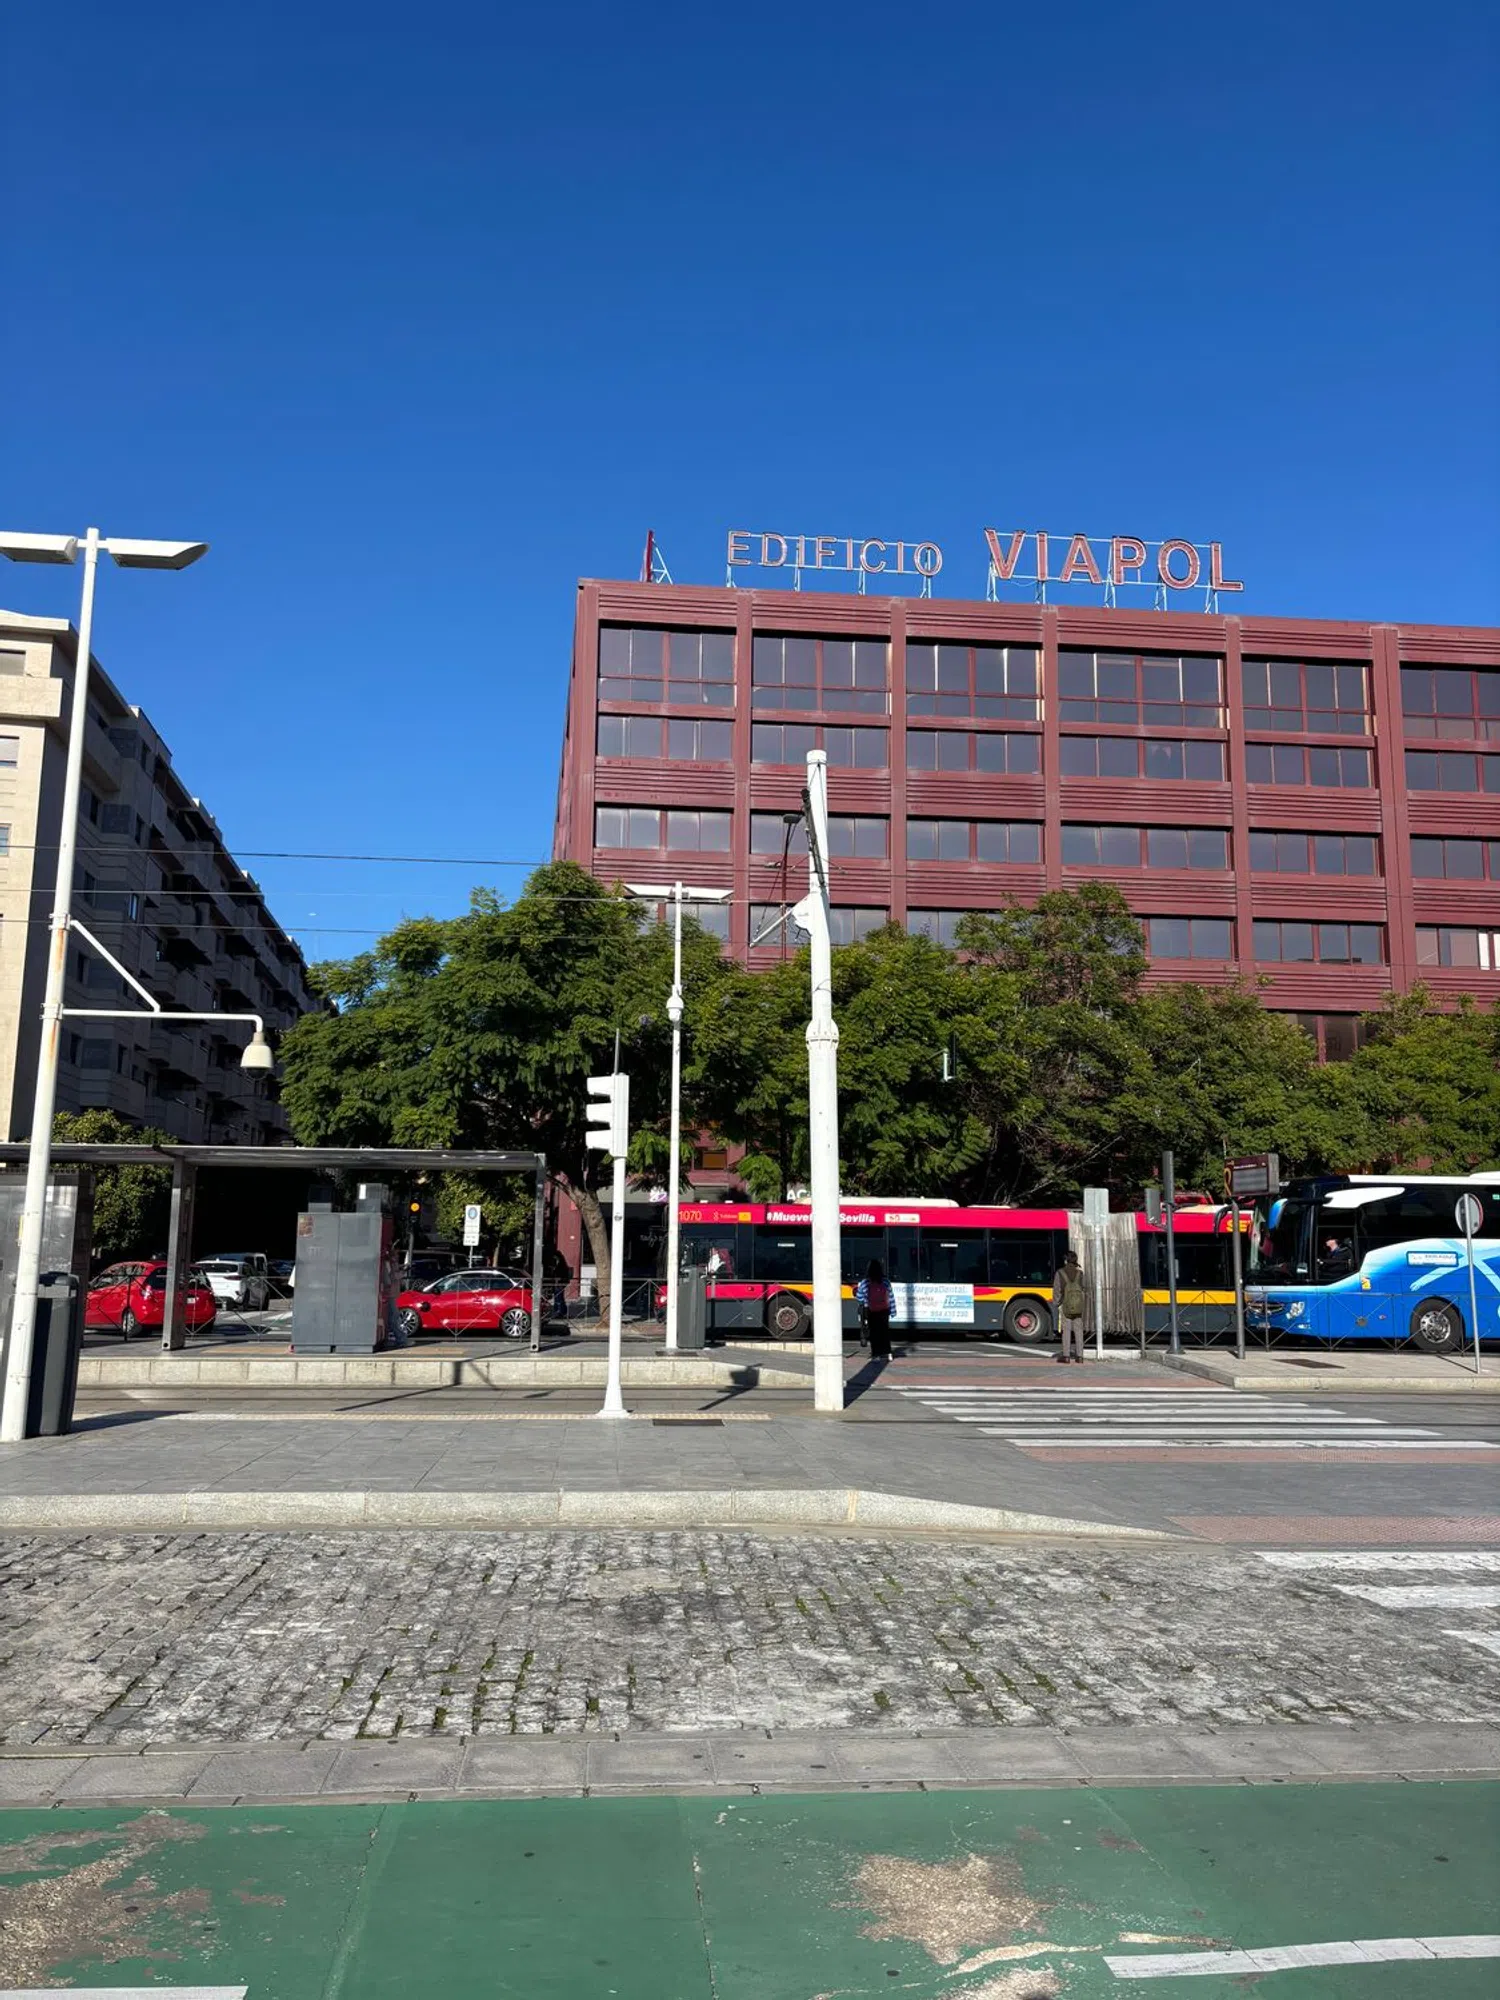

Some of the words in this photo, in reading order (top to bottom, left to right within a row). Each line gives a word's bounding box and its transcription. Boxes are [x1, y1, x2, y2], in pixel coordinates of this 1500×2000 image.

[727, 530, 943, 577] EDIFICIO
[984, 528, 1244, 592] VIAPOL
[679, 1210, 702, 1221] 1070
